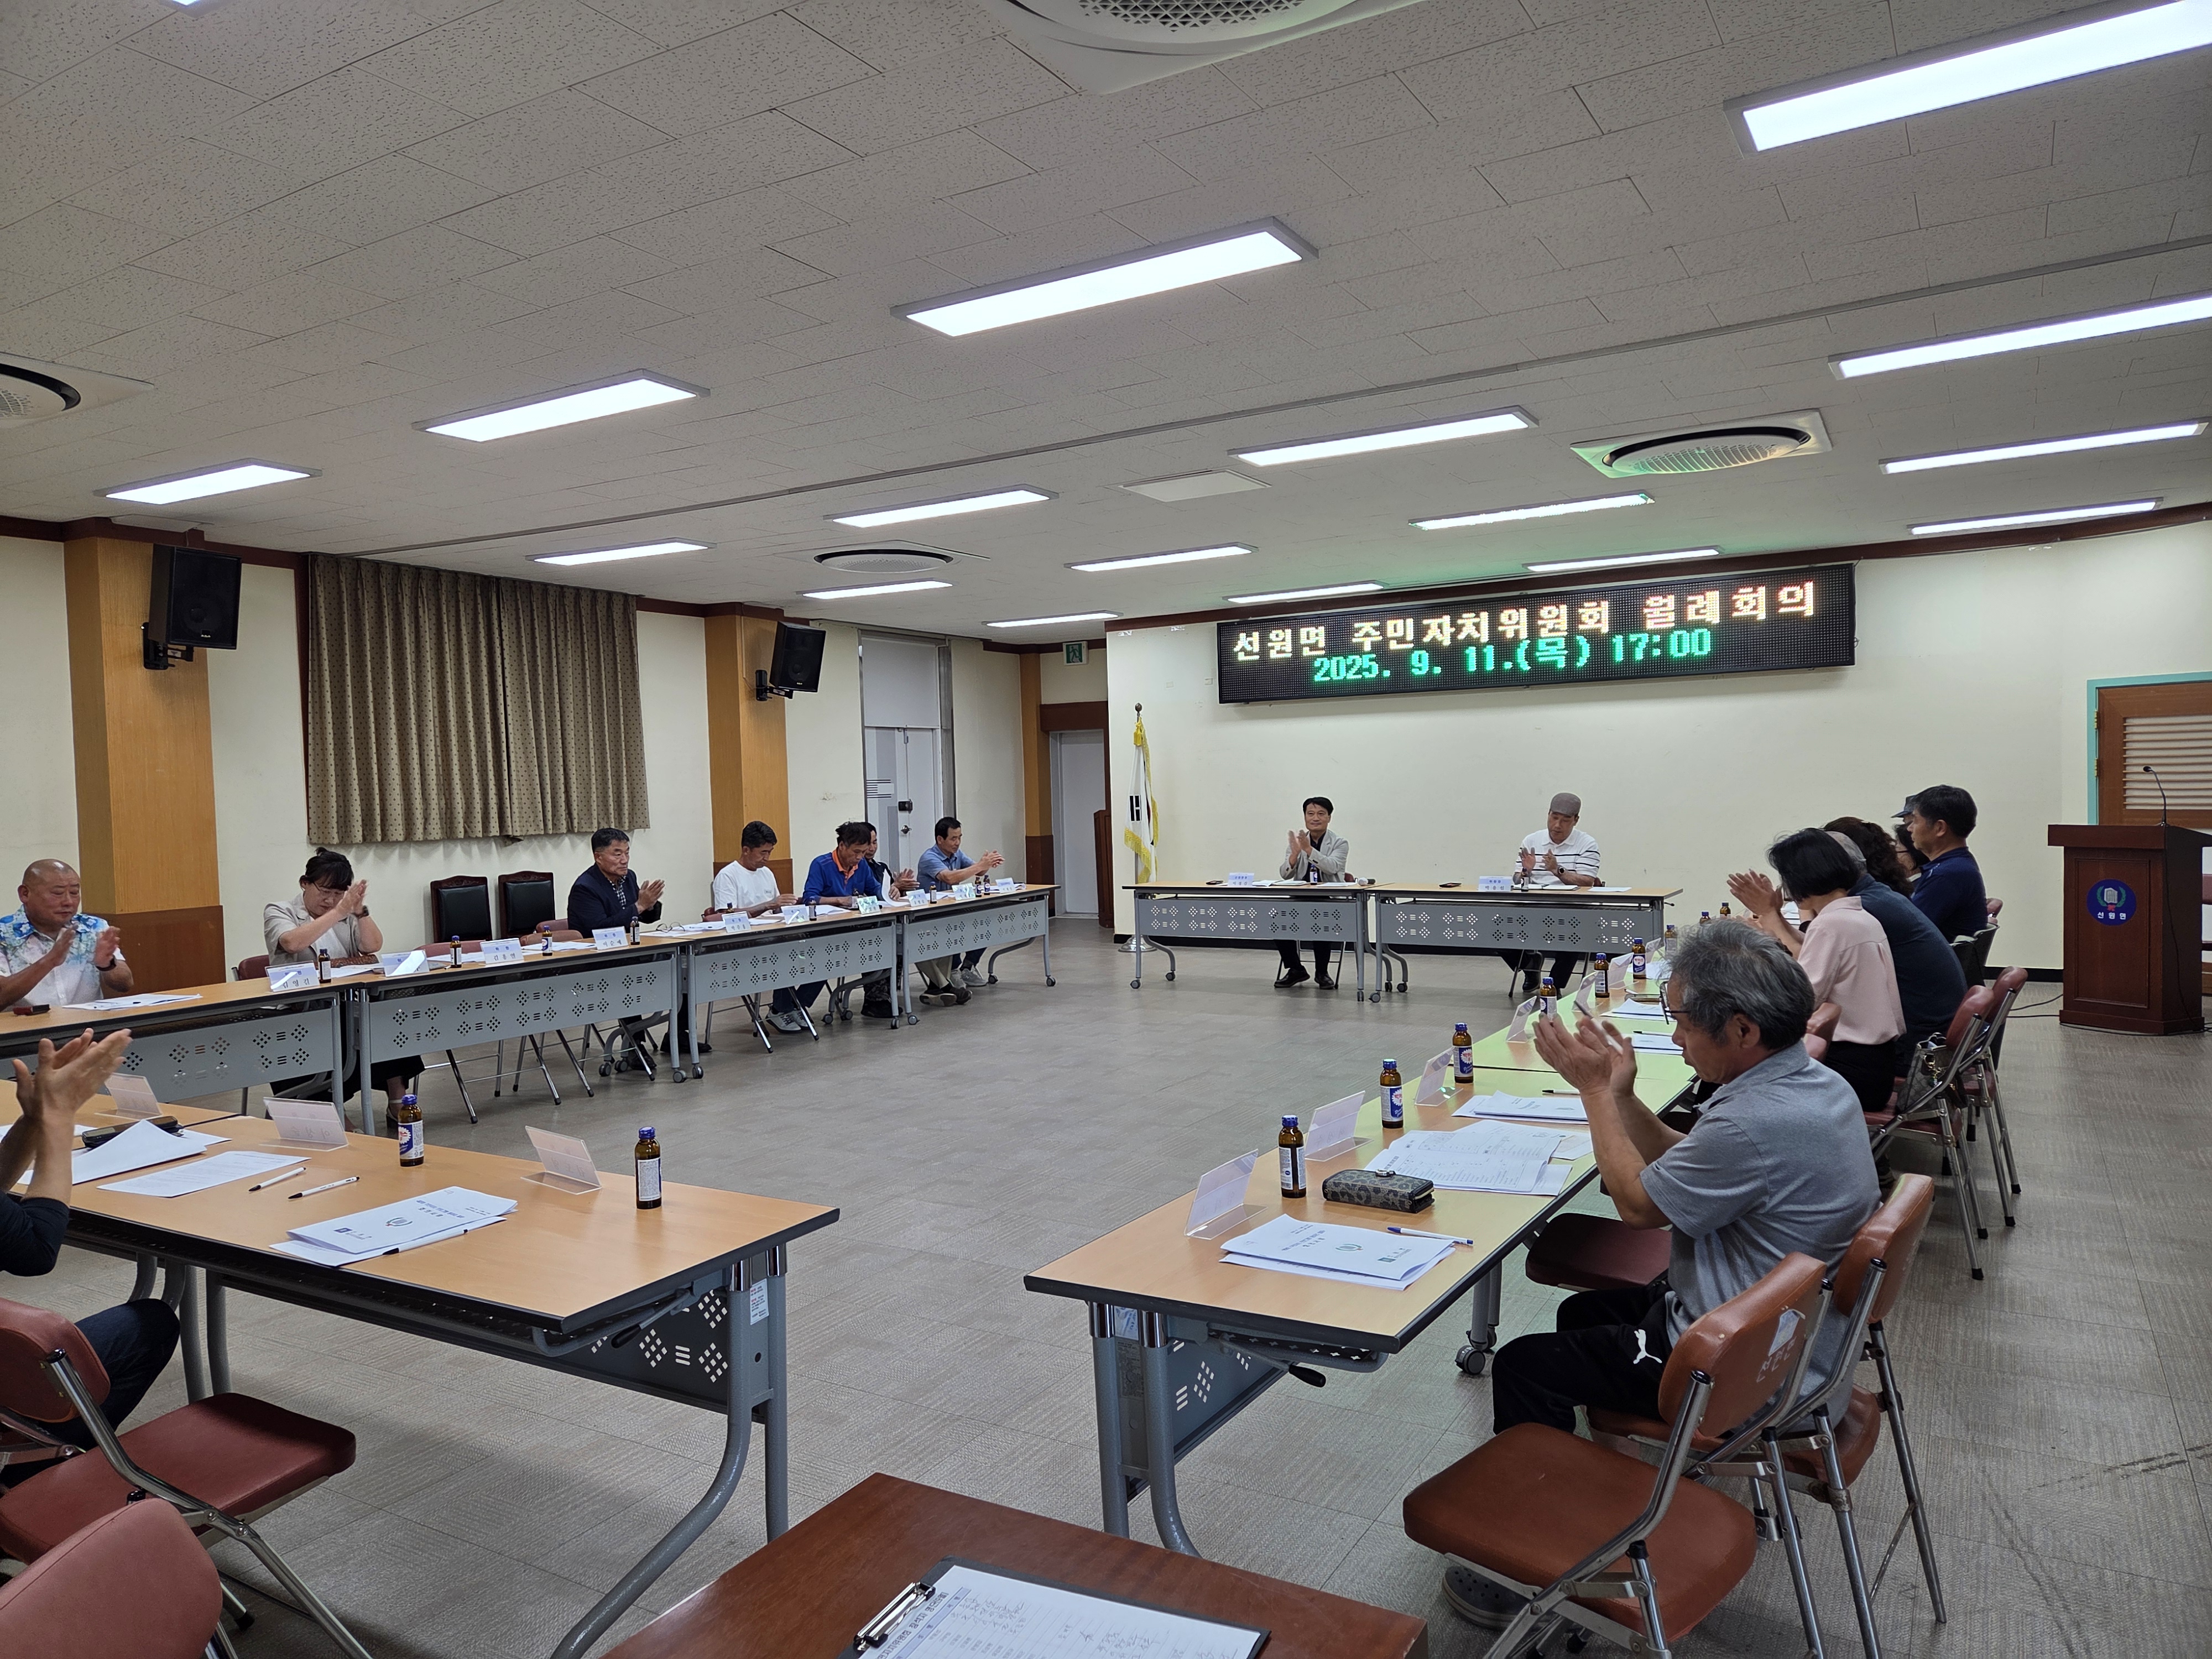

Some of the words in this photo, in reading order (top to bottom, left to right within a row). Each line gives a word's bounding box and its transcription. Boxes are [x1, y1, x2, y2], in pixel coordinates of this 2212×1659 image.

[1233, 626, 1326, 661] 선원면
[1352, 599, 1610, 649] 주민자치위원회
[1644, 581, 1815, 629] 월례회의
[1314, 654, 1390, 681] 2025.
[1411, 650, 1442, 676] 9.
[1465, 635, 1590, 672] 11.(목)
[1613, 628, 1713, 661] 17:00
[2098, 911, 2126, 920] 선원면
